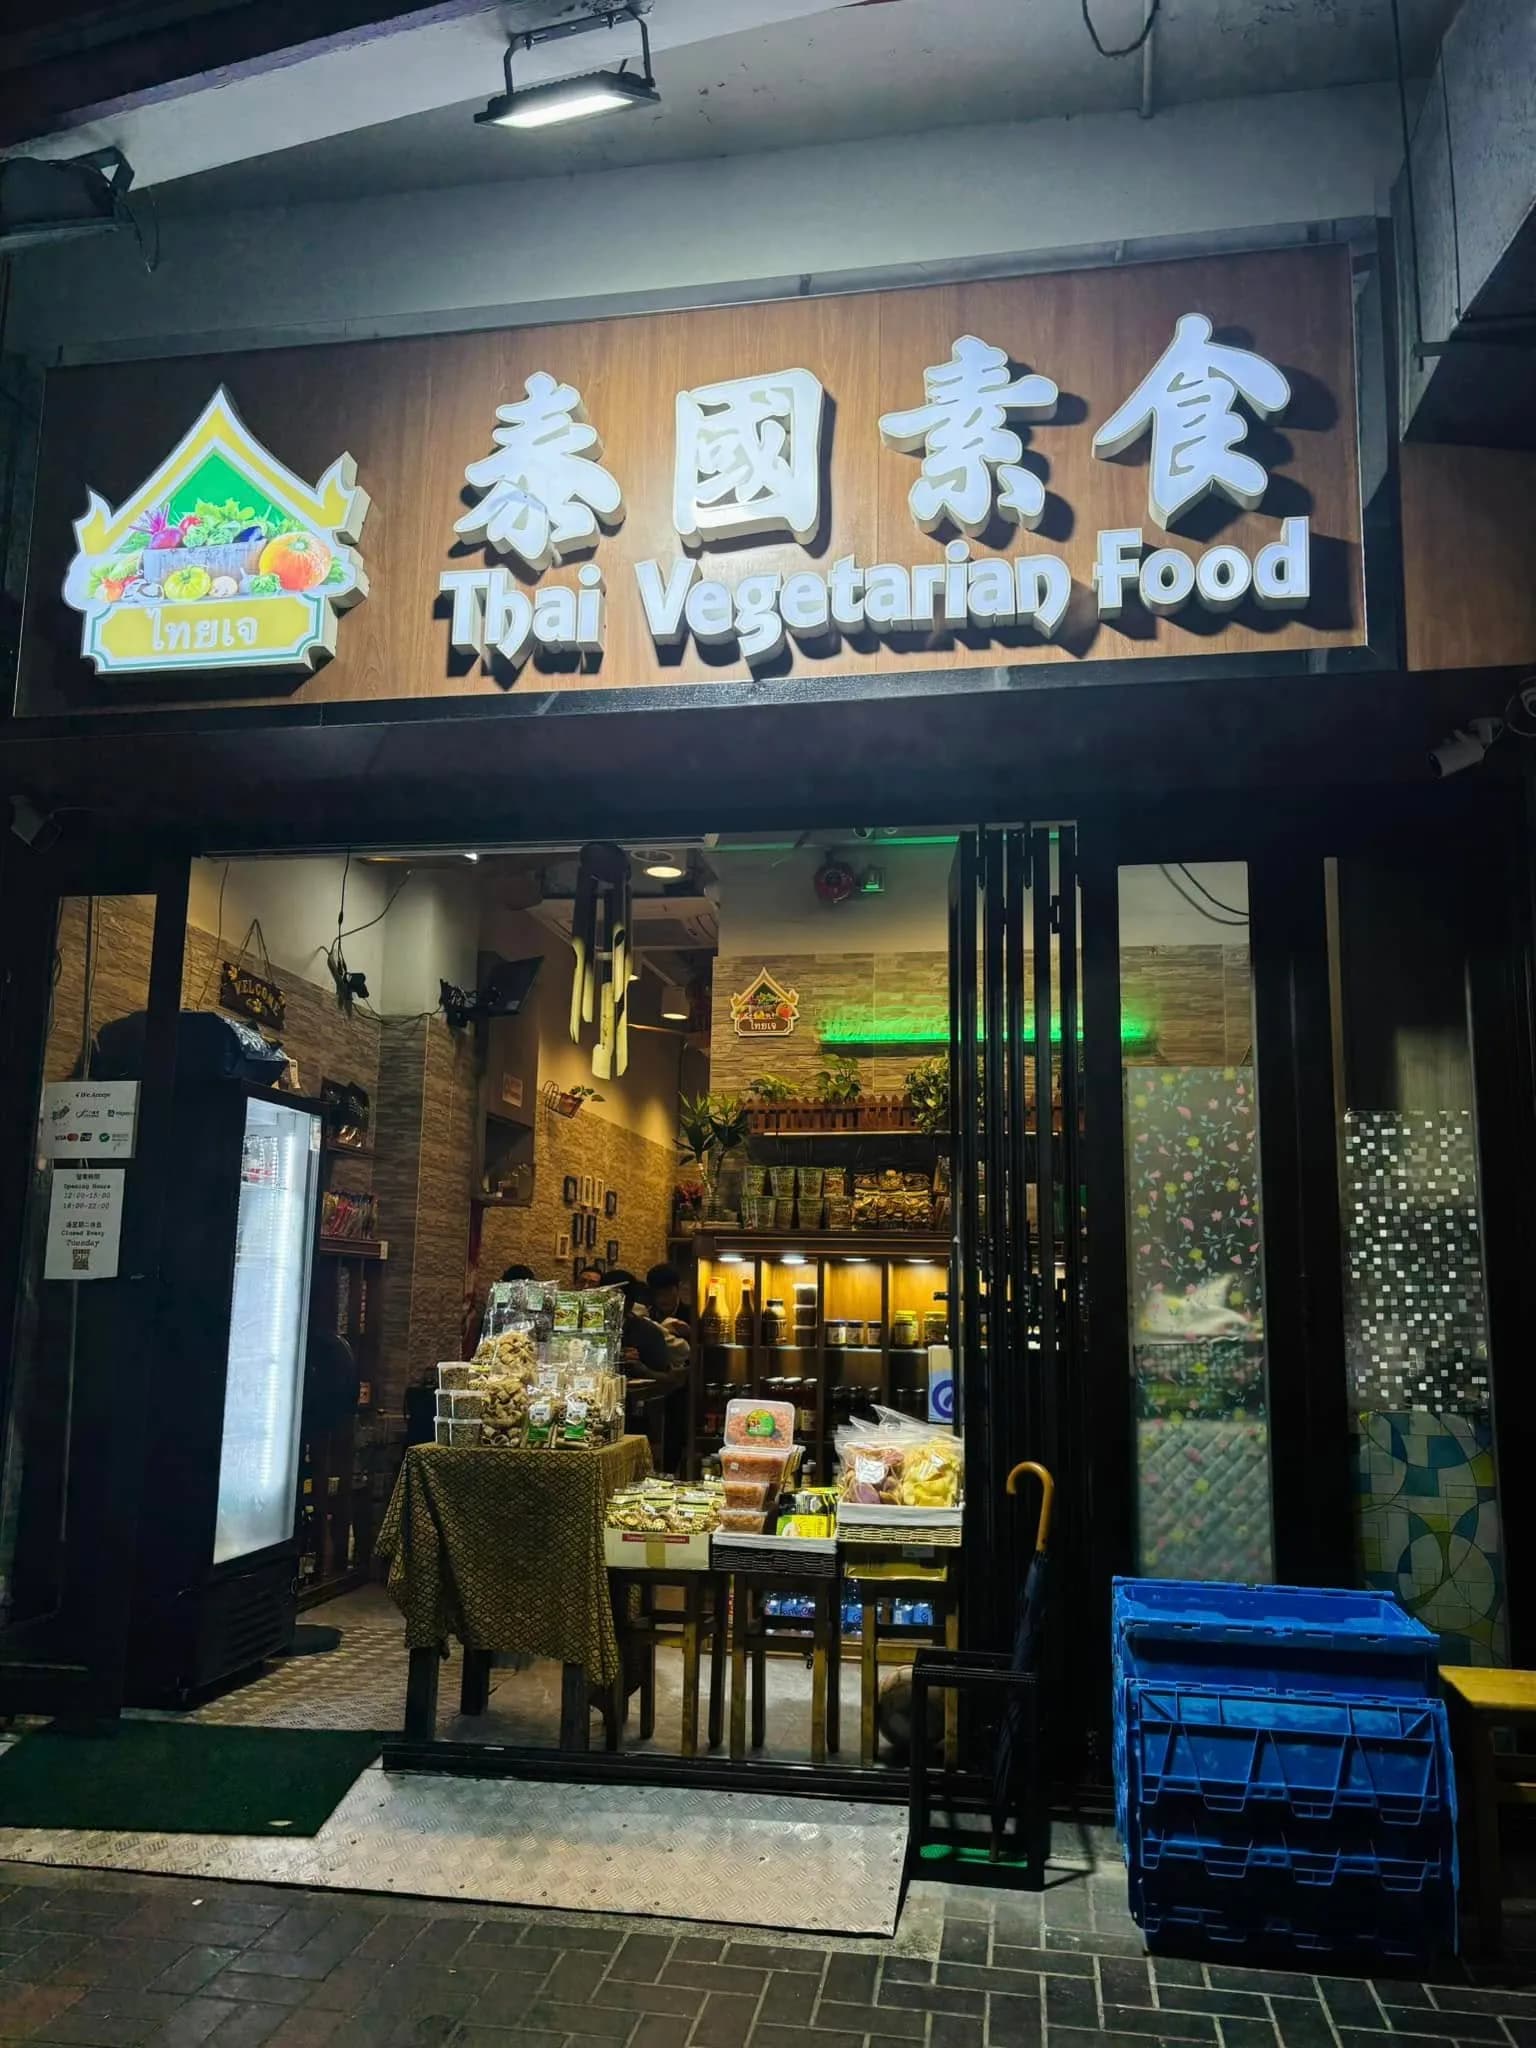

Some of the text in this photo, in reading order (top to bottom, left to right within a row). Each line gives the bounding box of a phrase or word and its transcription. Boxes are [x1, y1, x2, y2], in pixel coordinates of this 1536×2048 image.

[453, 313, 1291, 562] 泰國素食
[145, 608, 259, 651] ไทยเจ
[439, 516, 1311, 662] Thai Vegetarian Food
